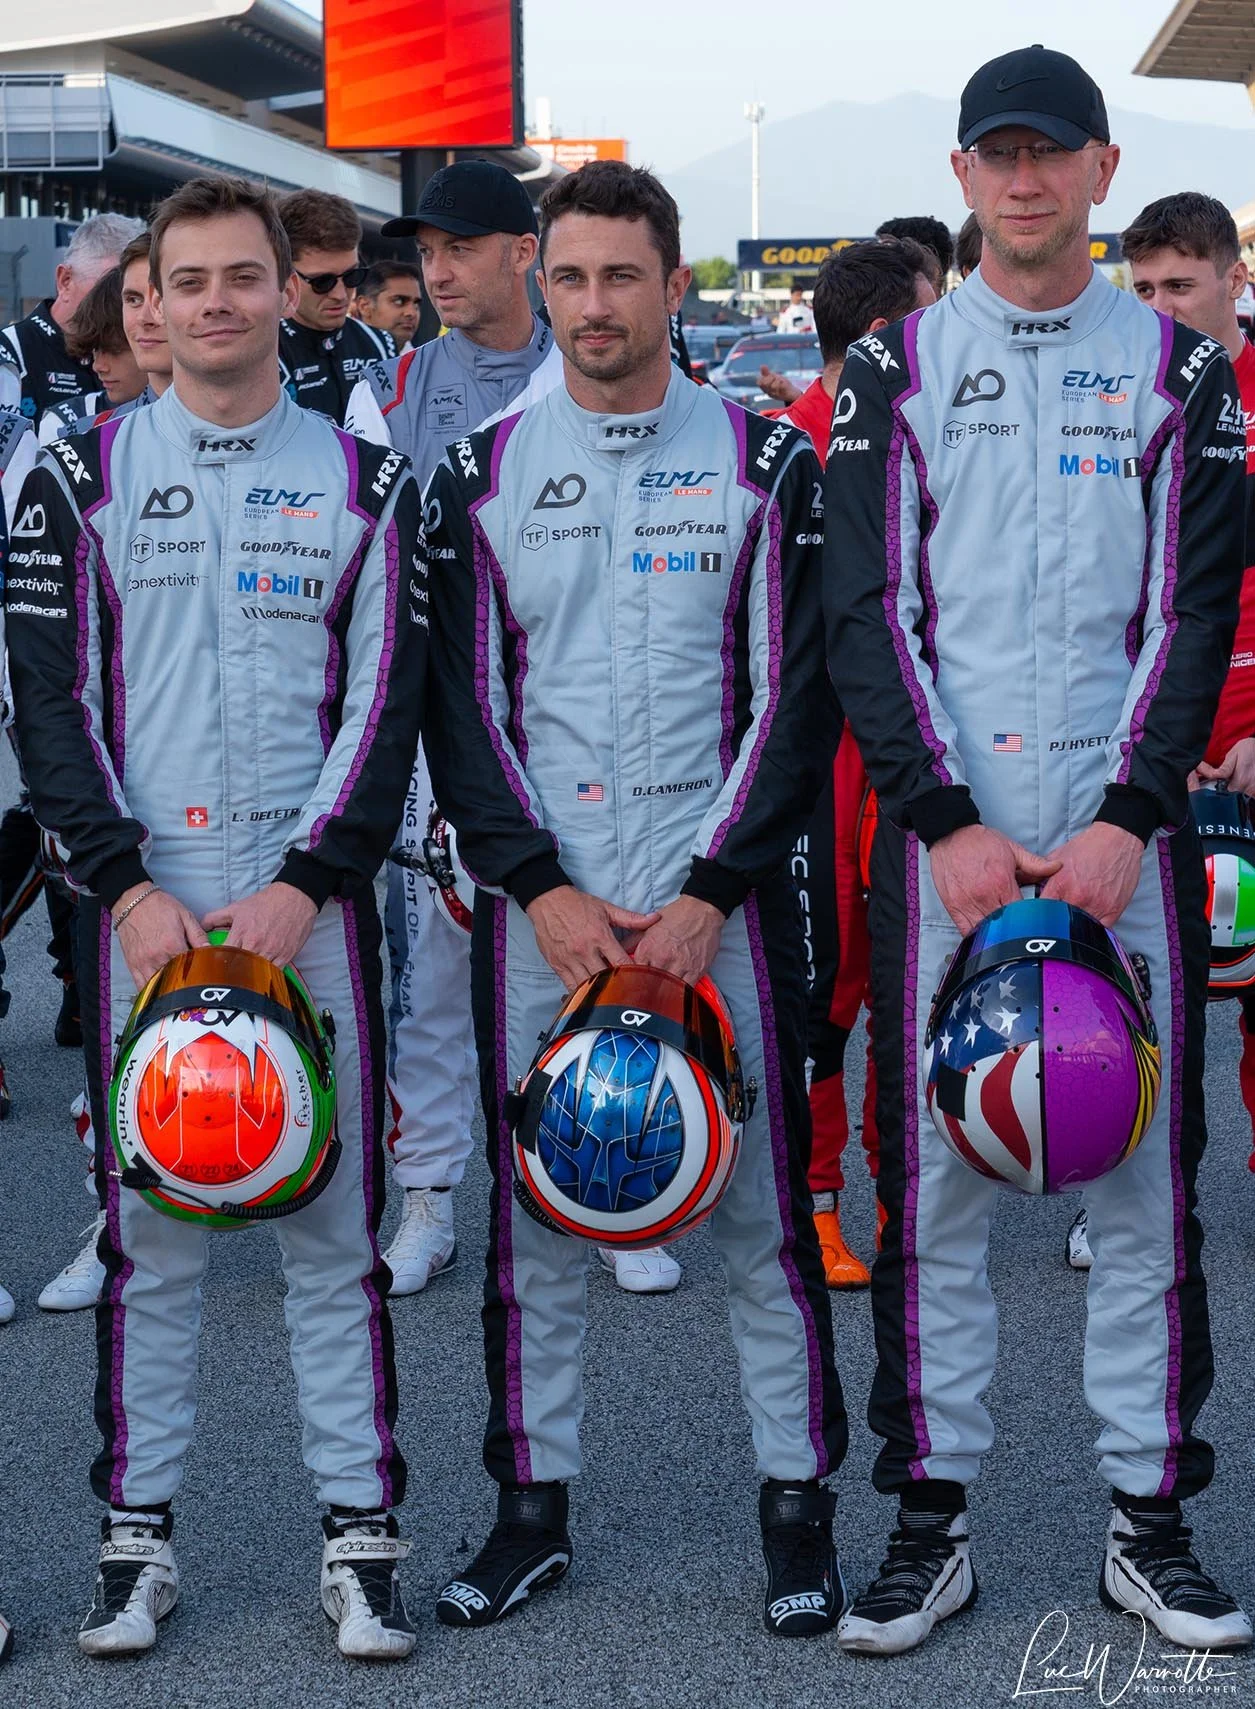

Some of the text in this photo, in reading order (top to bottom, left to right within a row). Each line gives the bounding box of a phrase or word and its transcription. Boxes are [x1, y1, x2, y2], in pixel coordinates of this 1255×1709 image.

[1011, 316, 1073, 335] HRX
[858, 334, 901, 373] HRX
[1179, 338, 1221, 382] HRX
[1062, 370, 1136, 394] ELMS
[605, 422, 660, 438] HRX
[946, 423, 1020, 442] TF SPORT
[198, 438, 257, 452] HRX
[756, 425, 792, 471] HRX
[50, 438, 93, 484] HRX
[455, 437, 479, 479] HRX
[1060, 454, 1119, 477] Mobil
[371, 450, 404, 497] HRX
[639, 471, 720, 488] ELMS
[245, 488, 325, 507] ELMS
[244, 507, 279, 515] EUROPEAN
[526, 526, 601, 544] TF SPORT
[634, 519, 728, 537] GOODYEAR
[133, 540, 206, 555] TF SPORT
[240, 541, 332, 560] GOODYEAR
[633, 552, 696, 573] Mobil
[237, 572, 299, 596] Mobil
[632, 779, 713, 797] D.CAMERON
[442, 1583, 486, 1612] OMP
[771, 1594, 826, 1619] OMP
